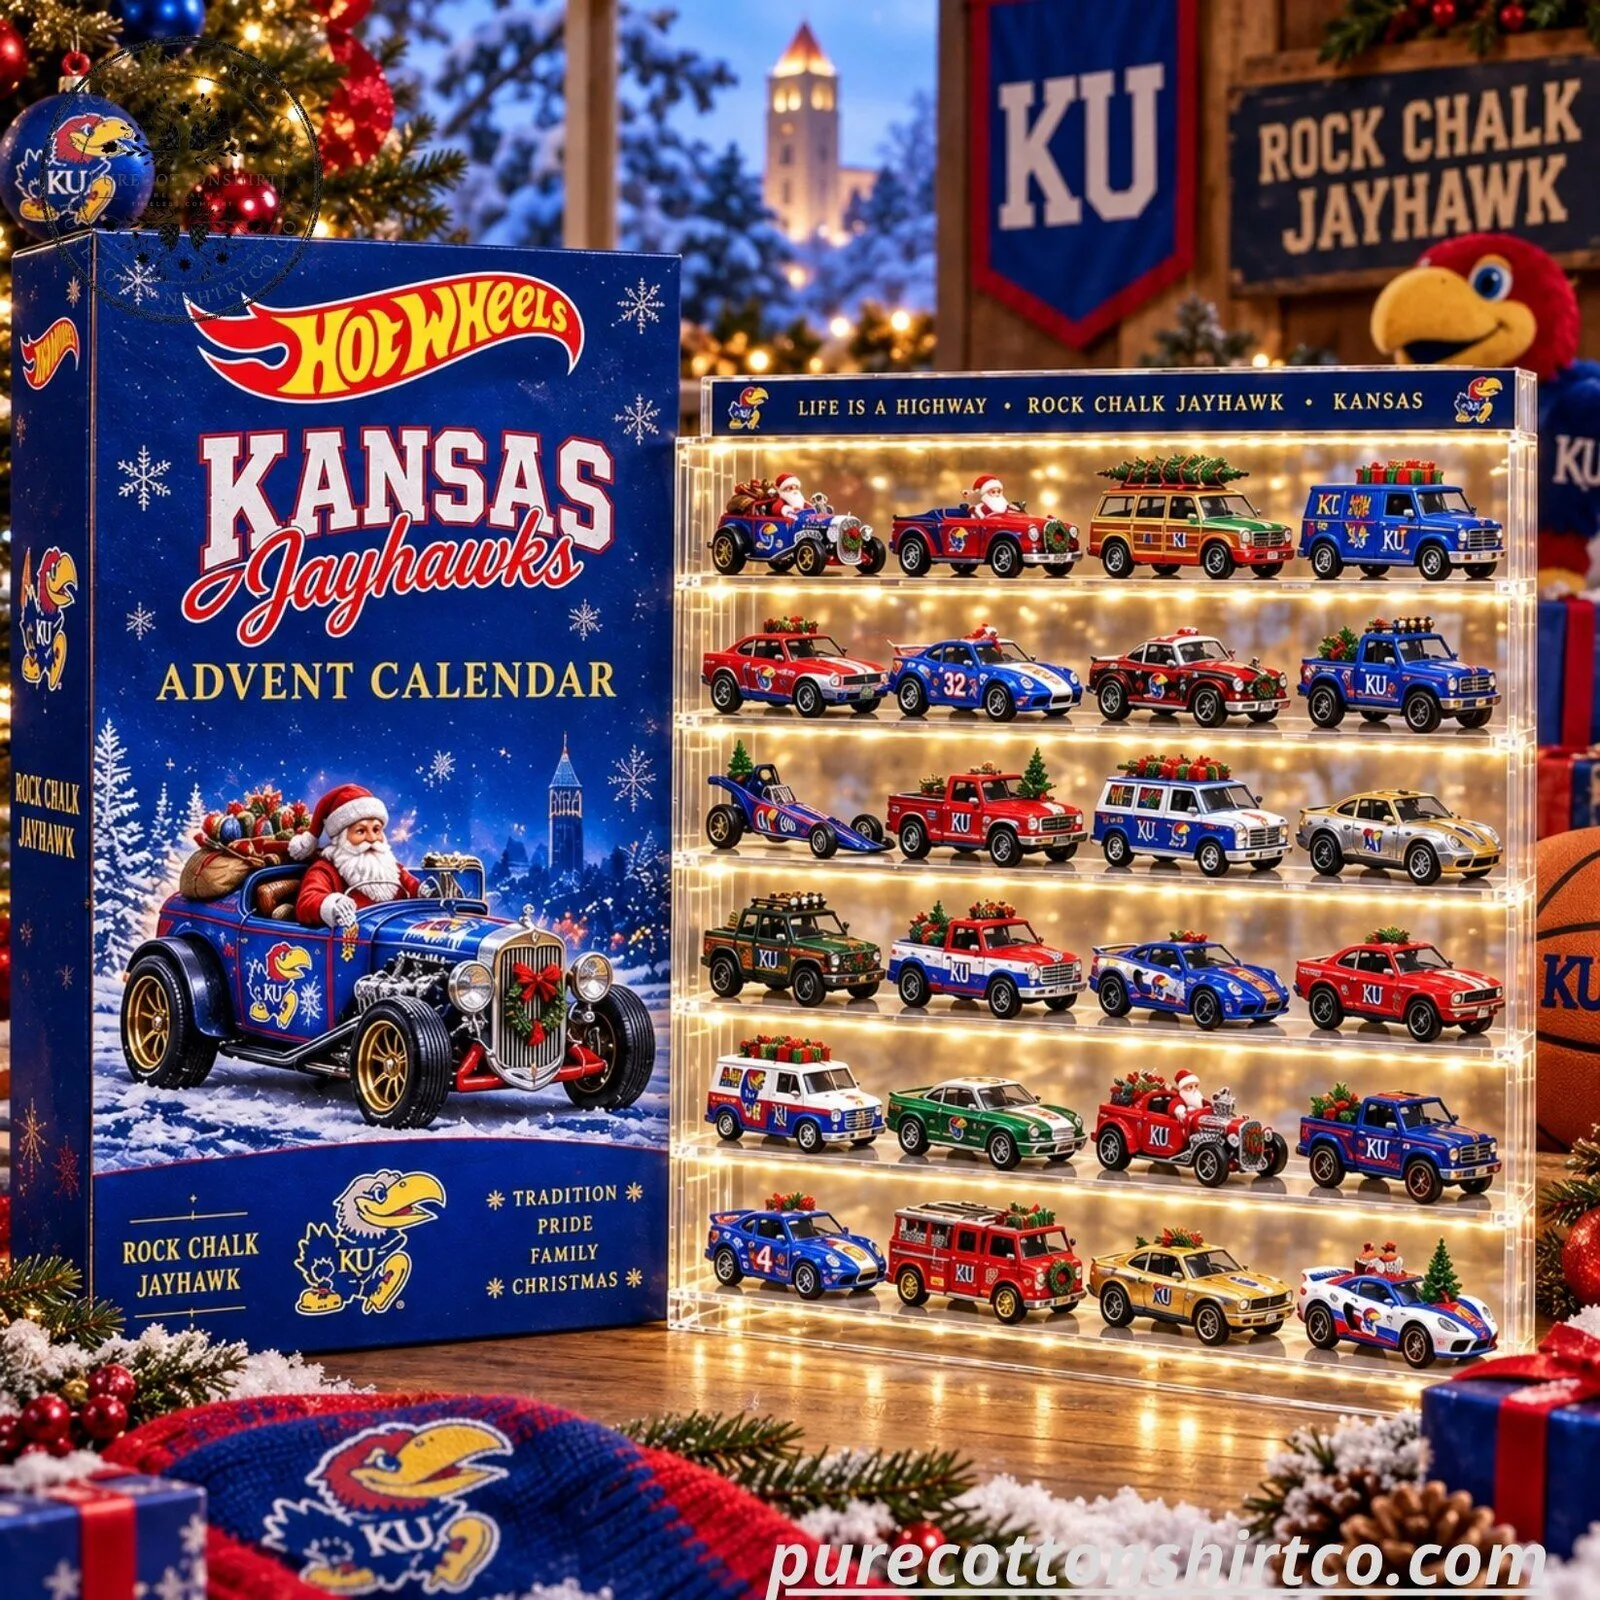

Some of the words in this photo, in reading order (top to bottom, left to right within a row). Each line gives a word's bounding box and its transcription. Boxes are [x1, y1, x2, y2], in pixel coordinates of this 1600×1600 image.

[1258, 107, 1385, 185] ROCK
[1403, 79, 1583, 162] CHALK
[999, 63, 1166, 230] KU
[46, 170, 87, 195] KU
[1282, 155, 1569, 254] JAYHAWK
[798, 400, 840, 416] LIFE
[847, 400, 866, 415] IS
[874, 400, 887, 415] A
[896, 398, 988, 415] HIGHWAY
[1027, 396, 1085, 414] ROCK
[1094, 395, 1166, 413] CHALK
[1176, 393, 1285, 413] JAYHAWK
[1333, 392, 1424, 411] KANSAS
[200, 425, 617, 574] KANSAS
[1380, 529, 1408, 552] KU
[180, 508, 583, 648] Jayhawks
[35, 619, 52, 647] KU
[158, 664, 353, 702] ADVENT
[371, 661, 616, 699] CALENDAR
[943, 672, 967, 697] 32
[1364, 673, 1387, 697] KU
[15, 772, 42, 803] ROCK
[44, 779, 80, 815] CHALK
[952, 812, 971, 833] KU
[18, 815, 75, 859] JAYHAWK
[951, 961, 969, 984] KU
[263, 983, 282, 1004] KU
[1362, 984, 1384, 1006] KU
[1148, 1125, 1168, 1146] KU
[1365, 1138, 1388, 1160] KU
[513, 1184, 618, 1208] TRADITION
[537, 1215, 594, 1235] PRIDE
[123, 1238, 179, 1264] ROCK
[188, 1232, 259, 1261] CHALK
[530, 1243, 599, 1265] FAMILY
[756, 1245, 772, 1272] 4
[339, 1249, 374, 1273] KU
[955, 1263, 975, 1284] KU
[136, 1267, 241, 1298] JAYHAWK
[512, 1270, 618, 1297] CHRISTMAS
[362, 1518, 434, 1556] KU
